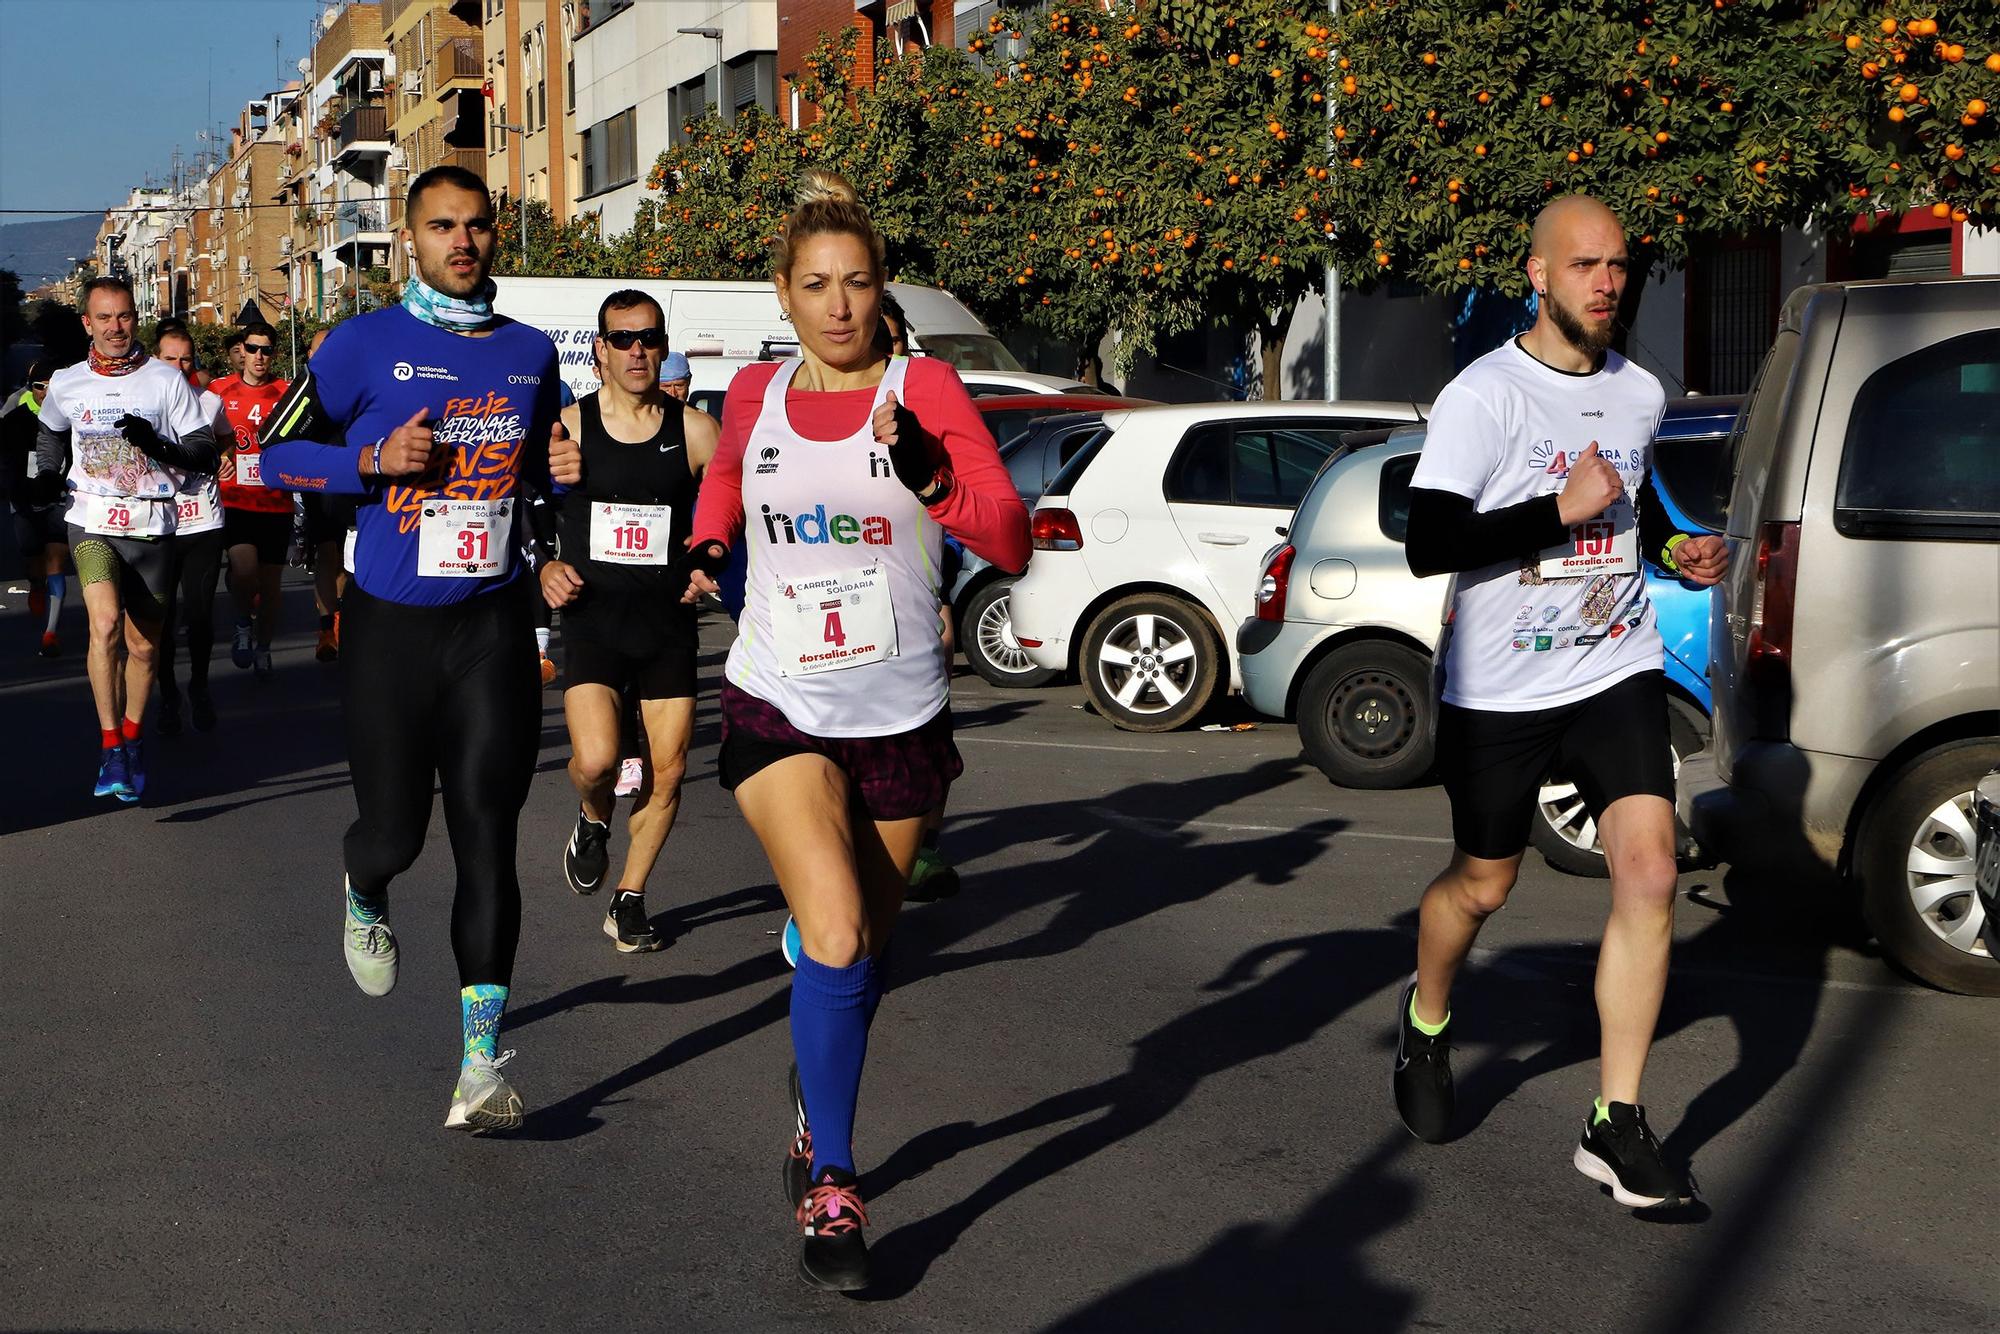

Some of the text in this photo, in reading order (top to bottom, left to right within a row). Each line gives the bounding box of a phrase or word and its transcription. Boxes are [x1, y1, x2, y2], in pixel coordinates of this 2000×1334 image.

[573, 330, 598, 345] GEN
[559, 350, 594, 366] IMPIE
[416, 365, 448, 375] nationale
[416, 372, 459, 382] nederlanden
[507, 374, 541, 385] OYSHO
[570, 378, 582, 390] de
[92, 408, 126, 416] CARRERA
[97, 414, 124, 422] SOLIDA
[247, 404, 262, 426] 4
[434, 414, 521, 432] NATIONALE
[432, 428, 529, 447] EDERLANDEN
[869, 451, 891, 478] in
[177, 502, 200, 519] 237
[613, 505, 641, 513] CARRERA
[107, 507, 131, 527] 29
[760, 503, 893, 546] indea
[457, 530, 489, 560] 31
[613, 526, 649, 551] 119
[1571, 521, 1615, 556] 157
[604, 549, 654, 559] dorsalia.com
[1562, 556, 1624, 567] dorsalia.com
[862, 567, 878, 577] 10K
[796, 579, 839, 591] CARRERA
[826, 580, 875, 595] SOLIDARIA
[823, 611, 847, 648] 4
[799, 644, 876, 663] dorsalia.com
